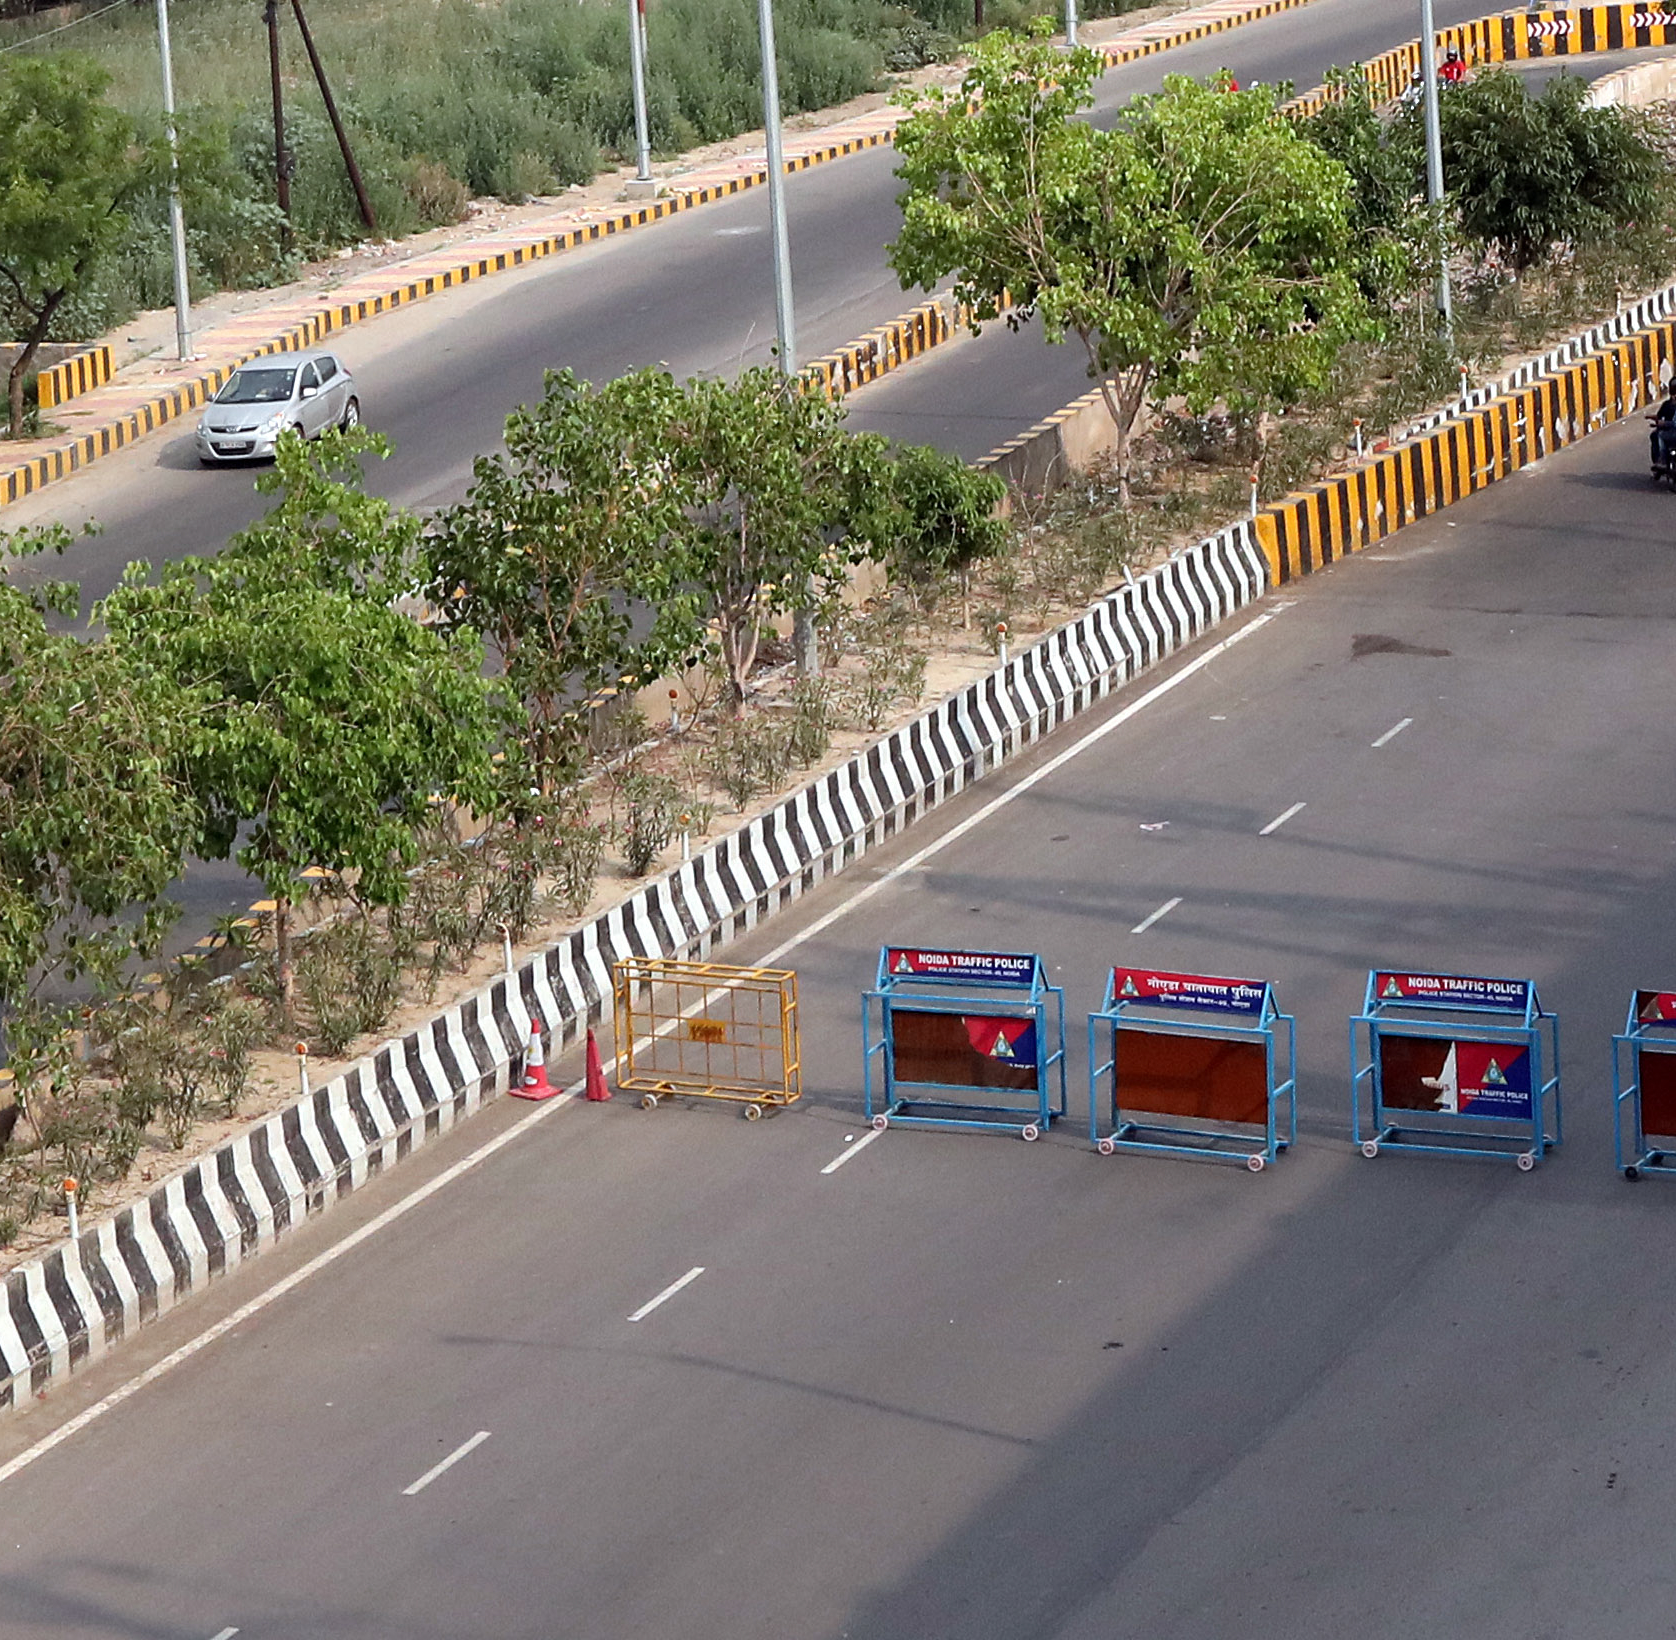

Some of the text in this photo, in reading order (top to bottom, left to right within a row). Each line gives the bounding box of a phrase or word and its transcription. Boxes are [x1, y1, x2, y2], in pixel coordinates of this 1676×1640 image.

[918, 954, 1030, 970] NOIDA TRAFFIC POLICE
[1147, 976, 1262, 999] नोएडा यातायात पुलिस
[1408, 977, 1523, 995] NOIDA TRAFFIC POLICE
[1460, 1088, 1479, 1096] NOIDA
[1480, 1089, 1505, 1098] TRAFFIC
[1507, 1092, 1528, 1100] POLICE
